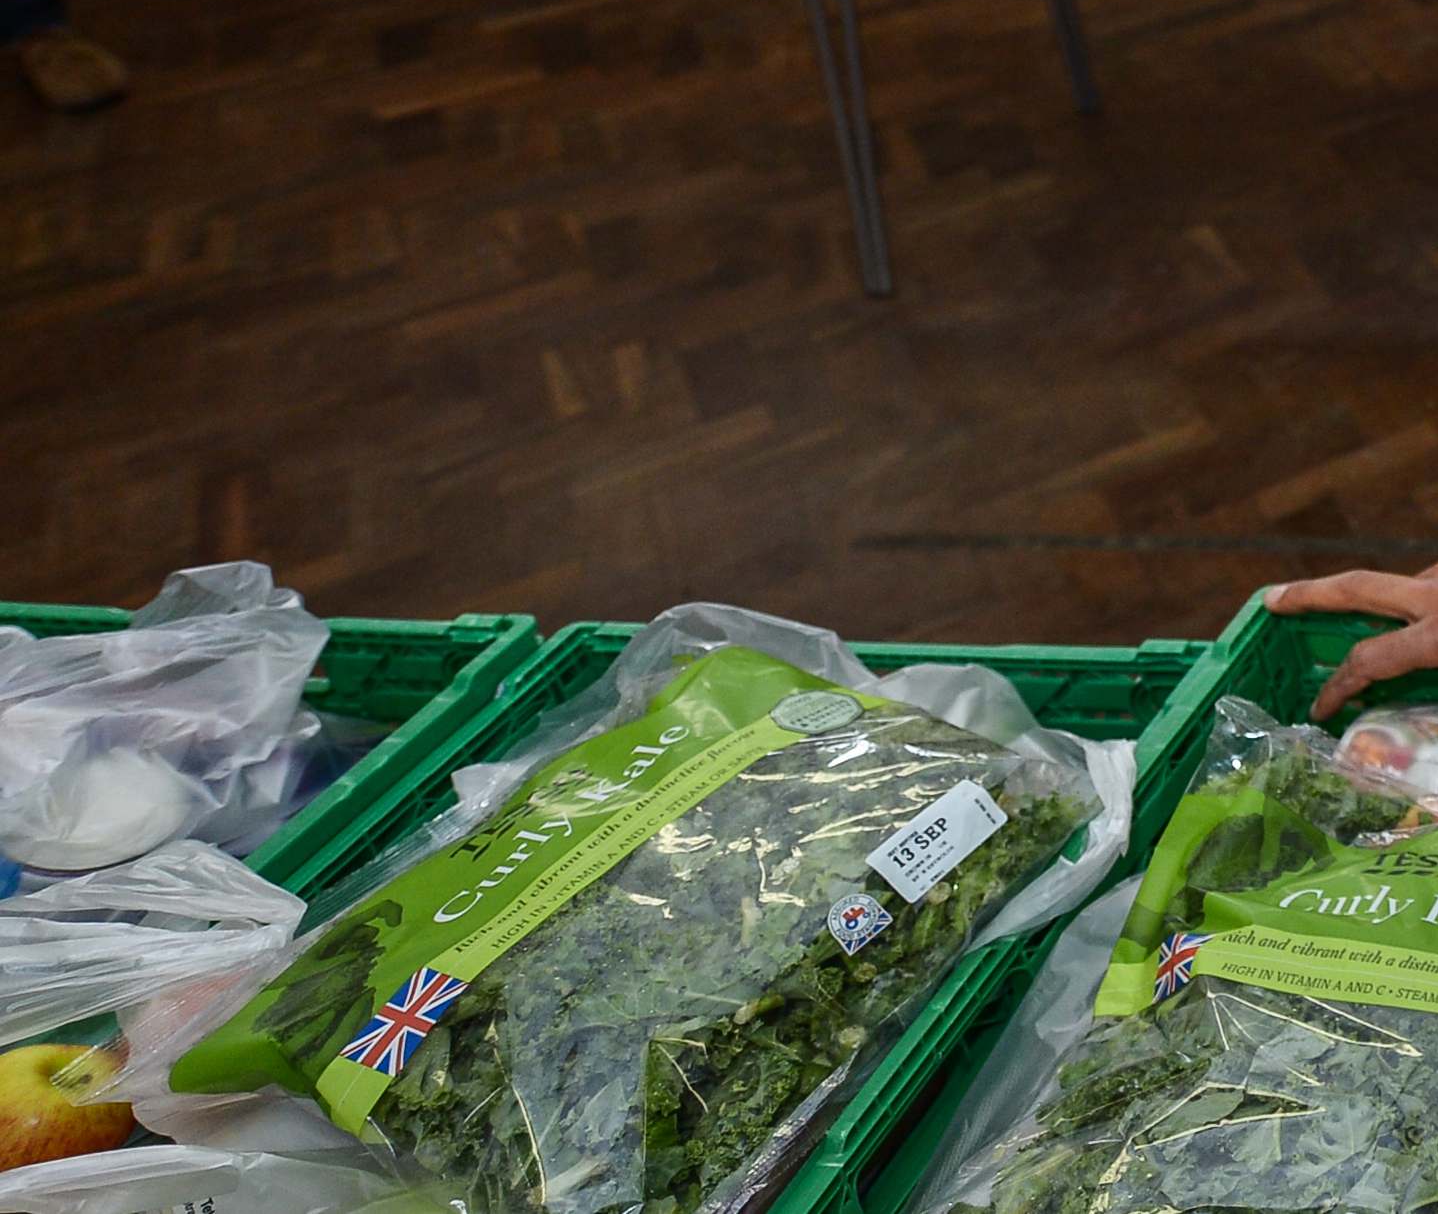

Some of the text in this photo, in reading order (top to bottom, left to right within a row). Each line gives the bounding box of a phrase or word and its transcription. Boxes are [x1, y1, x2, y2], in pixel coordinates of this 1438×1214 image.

[433, 811, 574, 924] Curly
[576, 725, 690, 802] Kale
[891, 847, 916, 869] 13
[914, 817, 948, 851] SEP
[1278, 885, 1415, 925] Curly
[1258, 938, 1290, 952] and
[1291, 939, 1347, 962] vibrant
[1348, 948, 1384, 966] with
[1385, 956, 1397, 968] a
[1222, 961, 1258, 978] HIGH
[1257, 967, 1275, 981] IN
[1275, 970, 1331, 990] VITAMIN
[1331, 981, 1342, 992] A
[1345, 982, 1374, 995] AND
